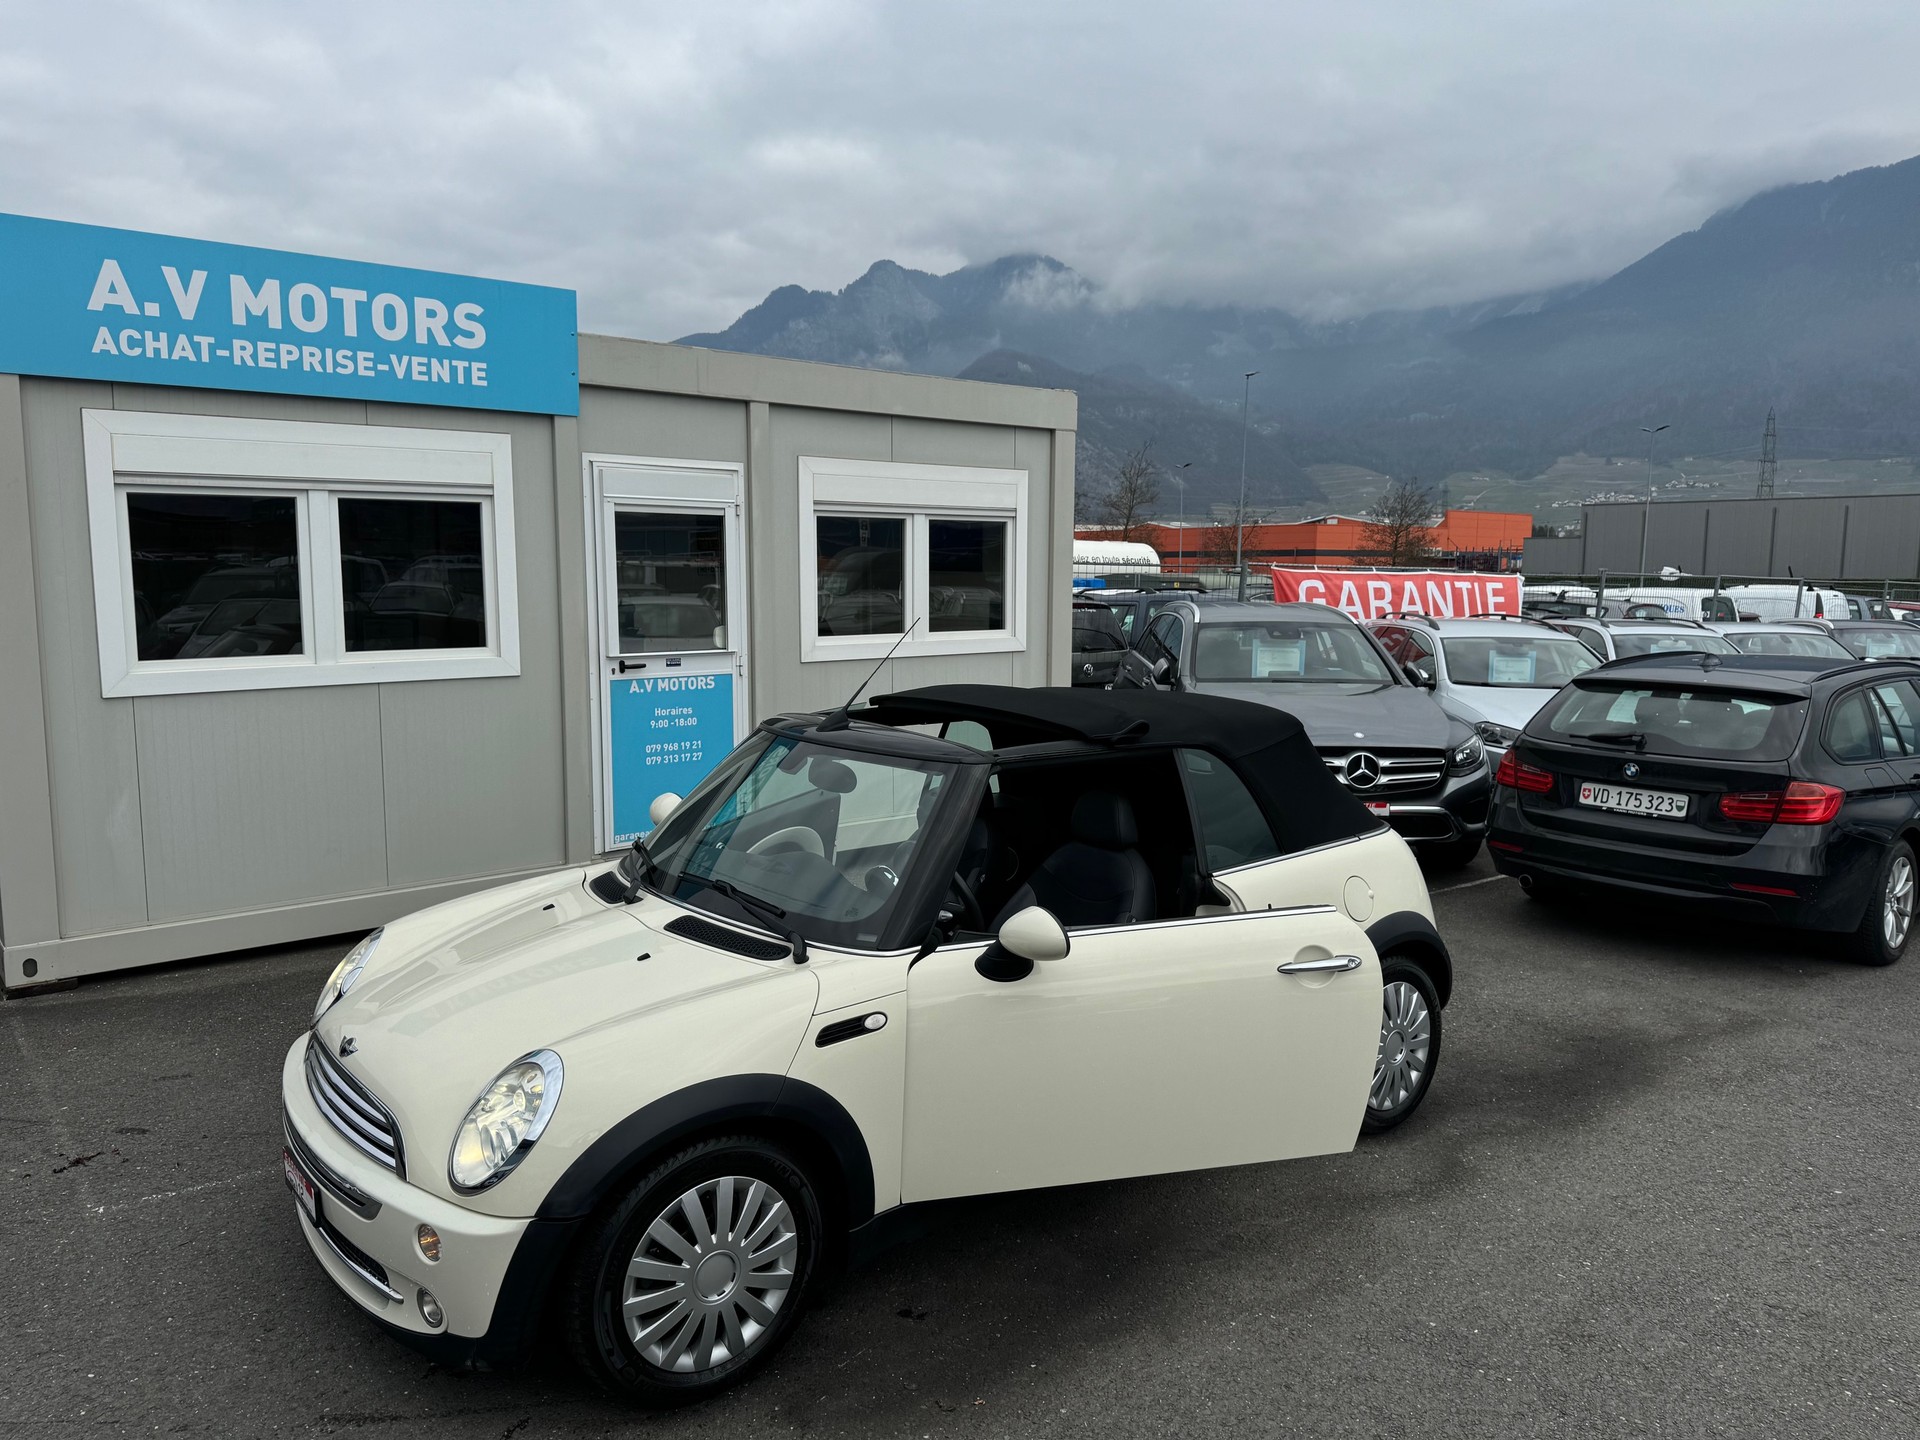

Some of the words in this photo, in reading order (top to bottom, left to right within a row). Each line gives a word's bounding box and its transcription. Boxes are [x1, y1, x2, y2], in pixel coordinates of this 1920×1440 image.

[87, 258, 208, 320] A.V
[230, 273, 487, 350] MOTORS
[92, 326, 488, 387] ACHAT-REPRISE-VENTE
[1299, 579, 1504, 620] GARANTIE
[1661, 603, 1685, 613] QUES
[629, 679, 654, 693] A.V
[658, 676, 715, 692] MOTORS
[654, 707, 693, 717] Horaires
[646, 744, 661, 753] 079
[663, 742, 679, 751] 968
[681, 741, 690, 750] 19
[692, 740, 702, 749] 21
[646, 756, 661, 766] 079
[663, 755, 679, 764] 313
[681, 753, 690, 762] 17
[692, 752, 703, 761] 27
[614, 831, 653, 844] garagea
